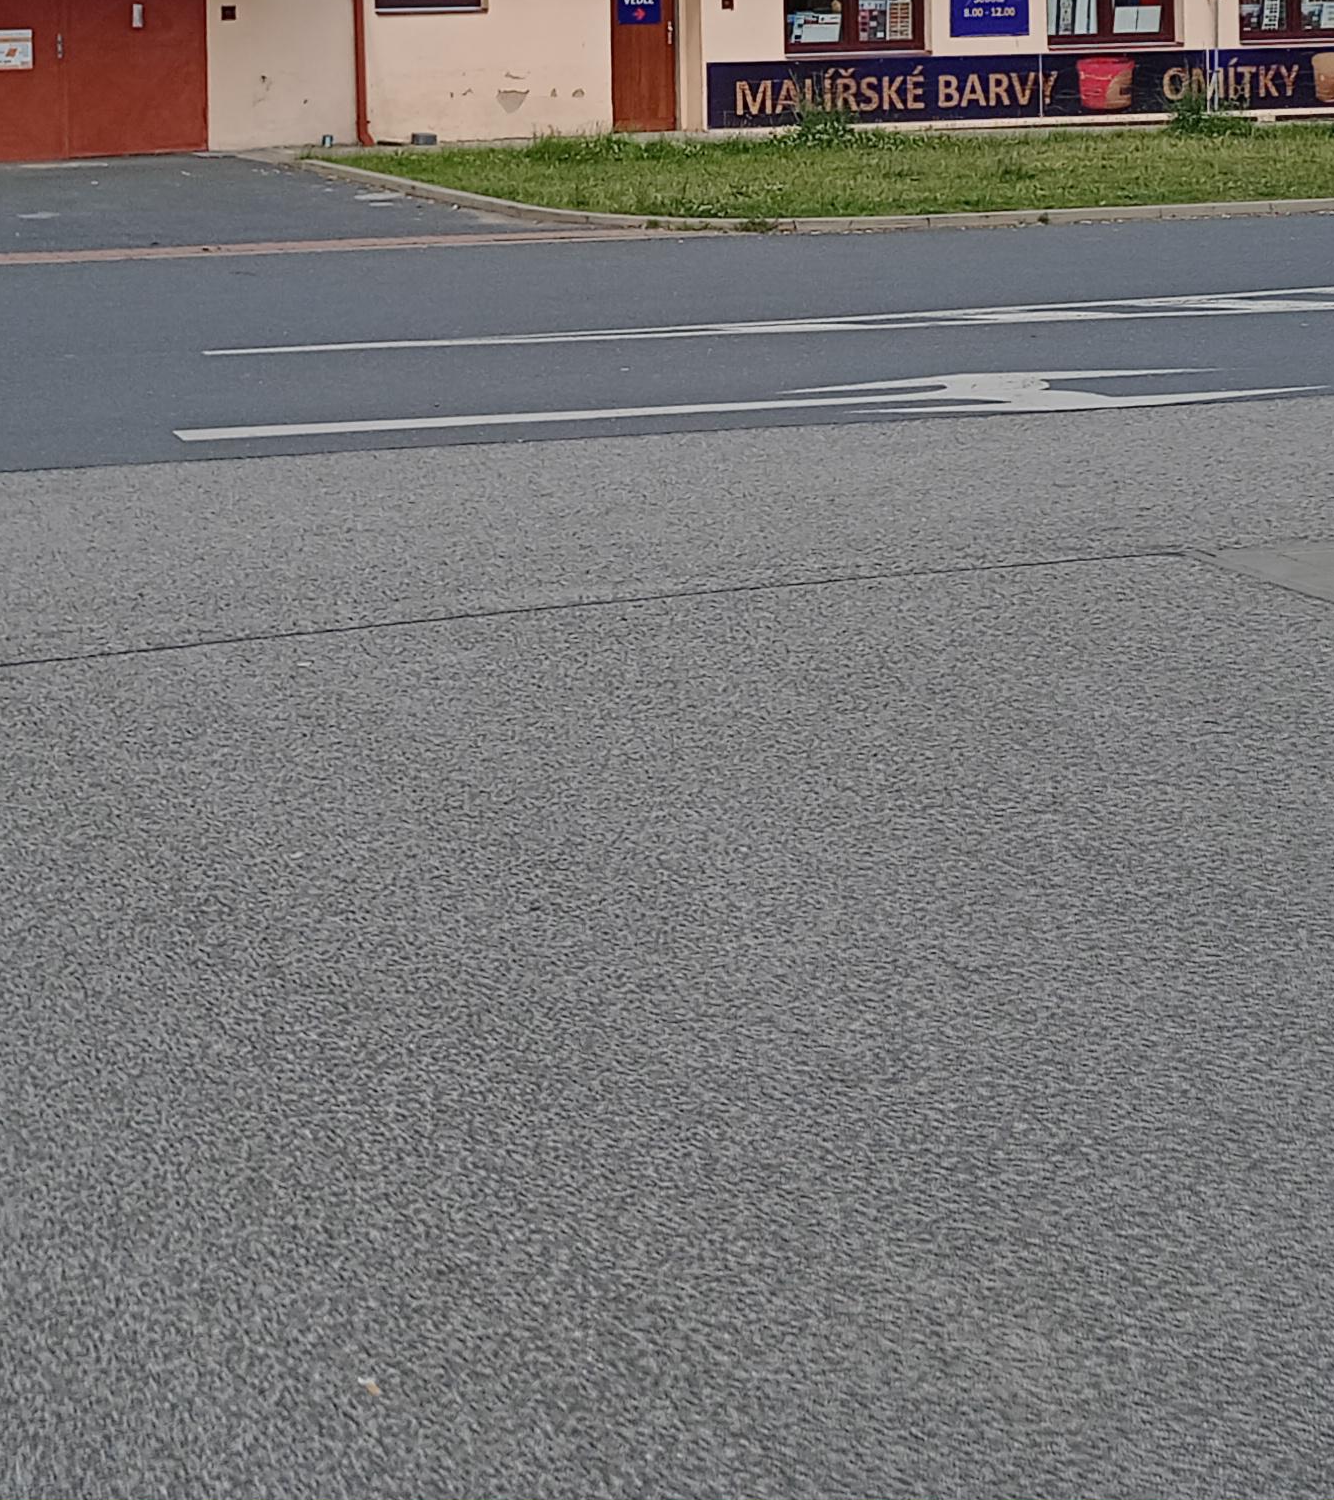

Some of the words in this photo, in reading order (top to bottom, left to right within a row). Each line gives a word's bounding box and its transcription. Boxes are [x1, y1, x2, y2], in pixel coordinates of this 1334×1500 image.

[963, 8, 984, 18] 8.00
[990, 7, 1016, 17] 12.00
[937, 70, 1059, 108] BARVY
